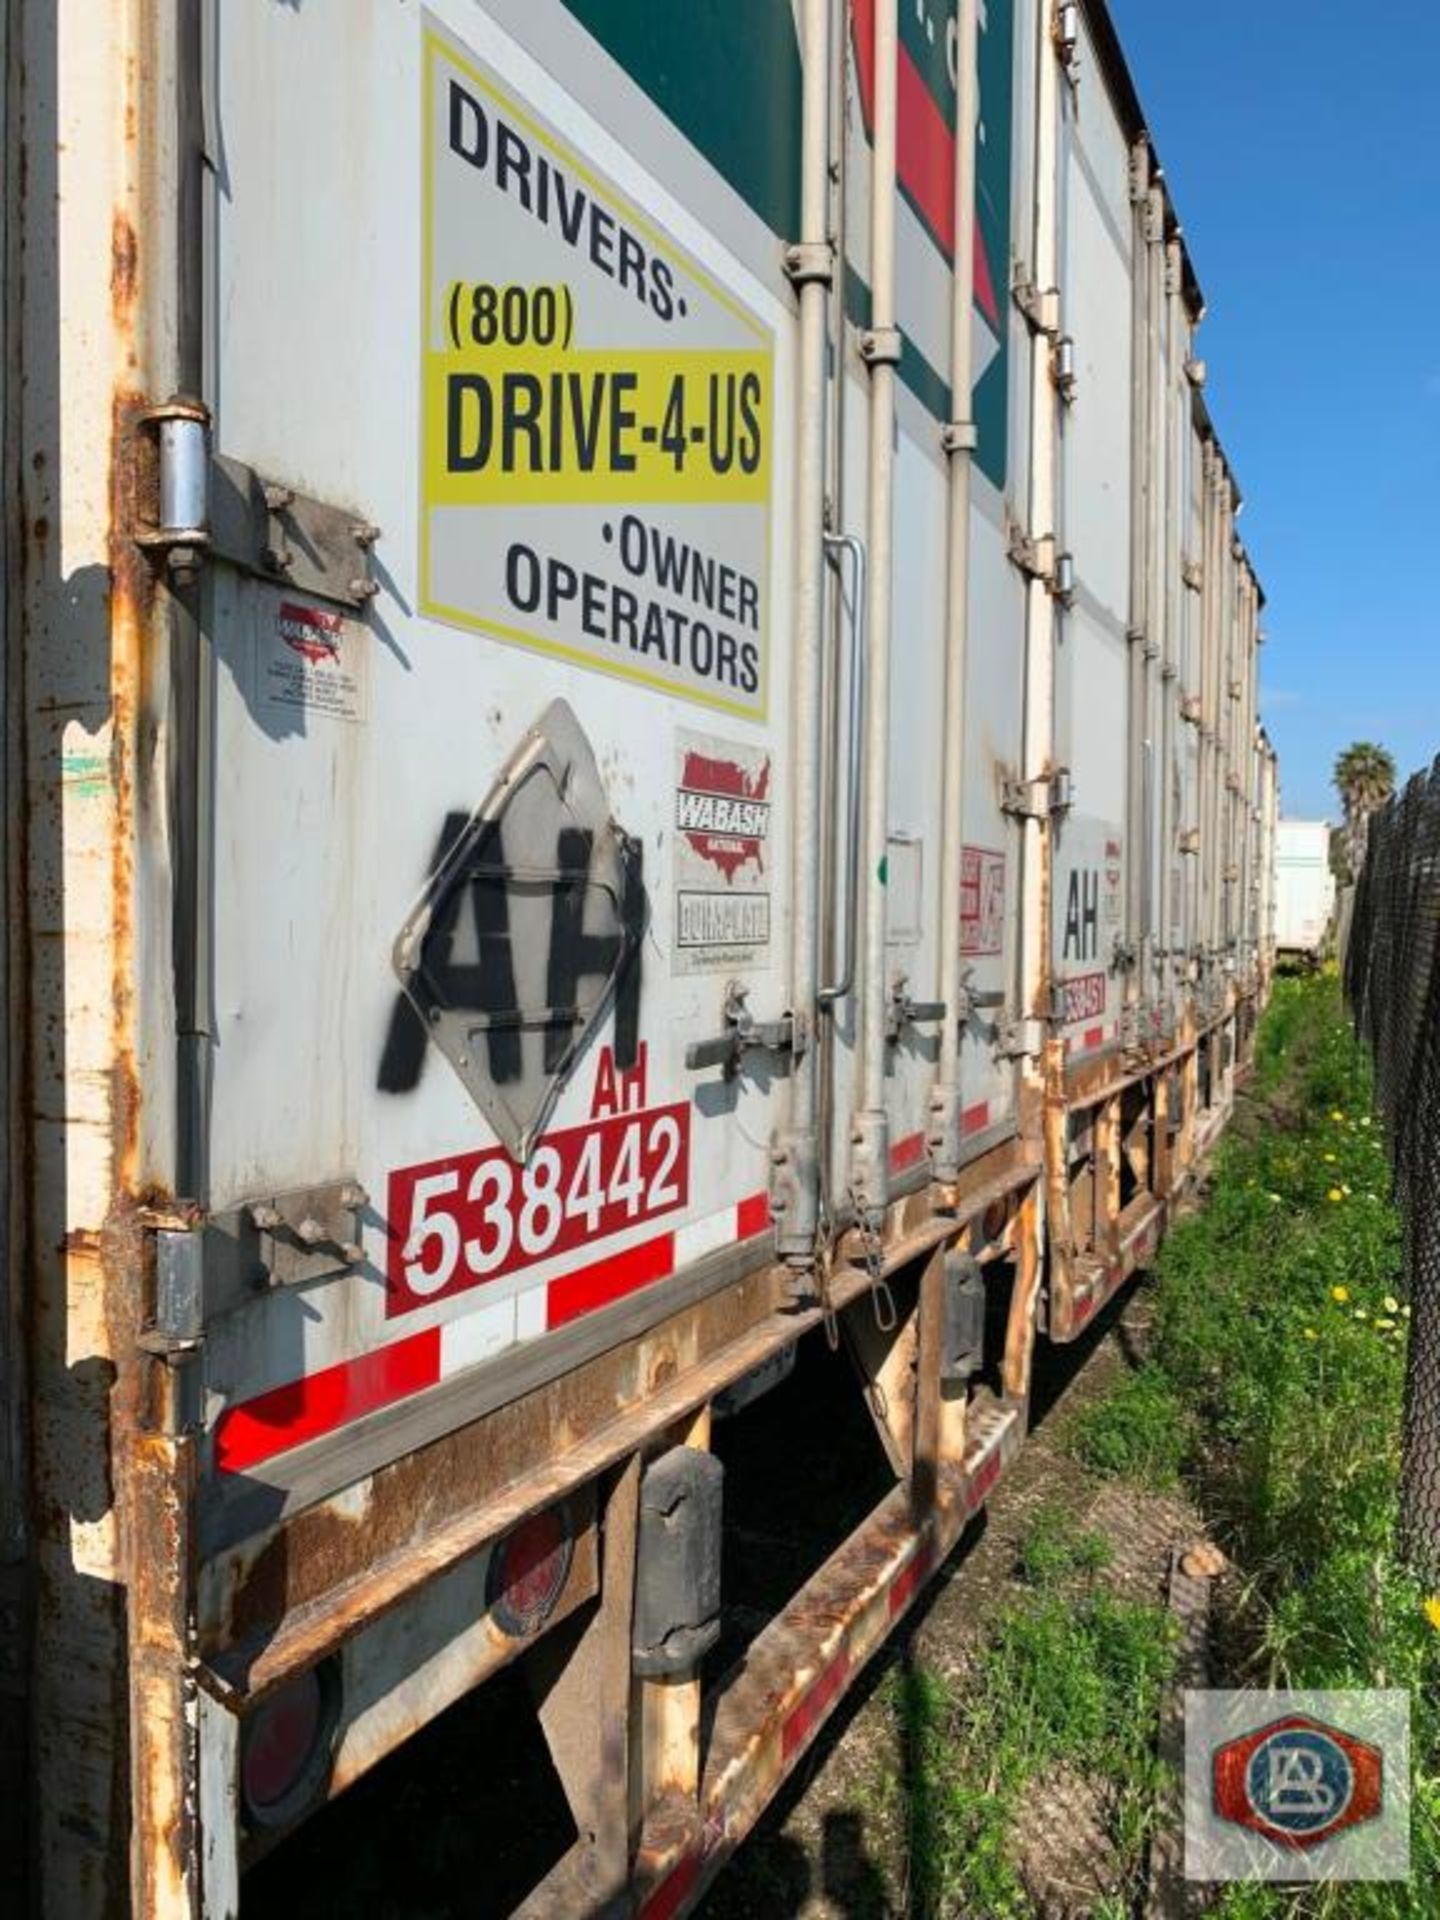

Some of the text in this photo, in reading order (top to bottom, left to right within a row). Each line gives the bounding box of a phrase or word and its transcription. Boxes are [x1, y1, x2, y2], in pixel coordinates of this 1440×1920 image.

[449, 282, 573, 349] (800)
[447, 372, 761, 475] DRIVE-4-US
[505, 542, 760, 694] OPERATORS
[677, 792, 769, 837] WABASH
[376, 811, 646, 1094] AH
[1063, 869, 1099, 961] AH
[590, 1040, 648, 1119] AH
[402, 1115, 681, 1297] 538442
